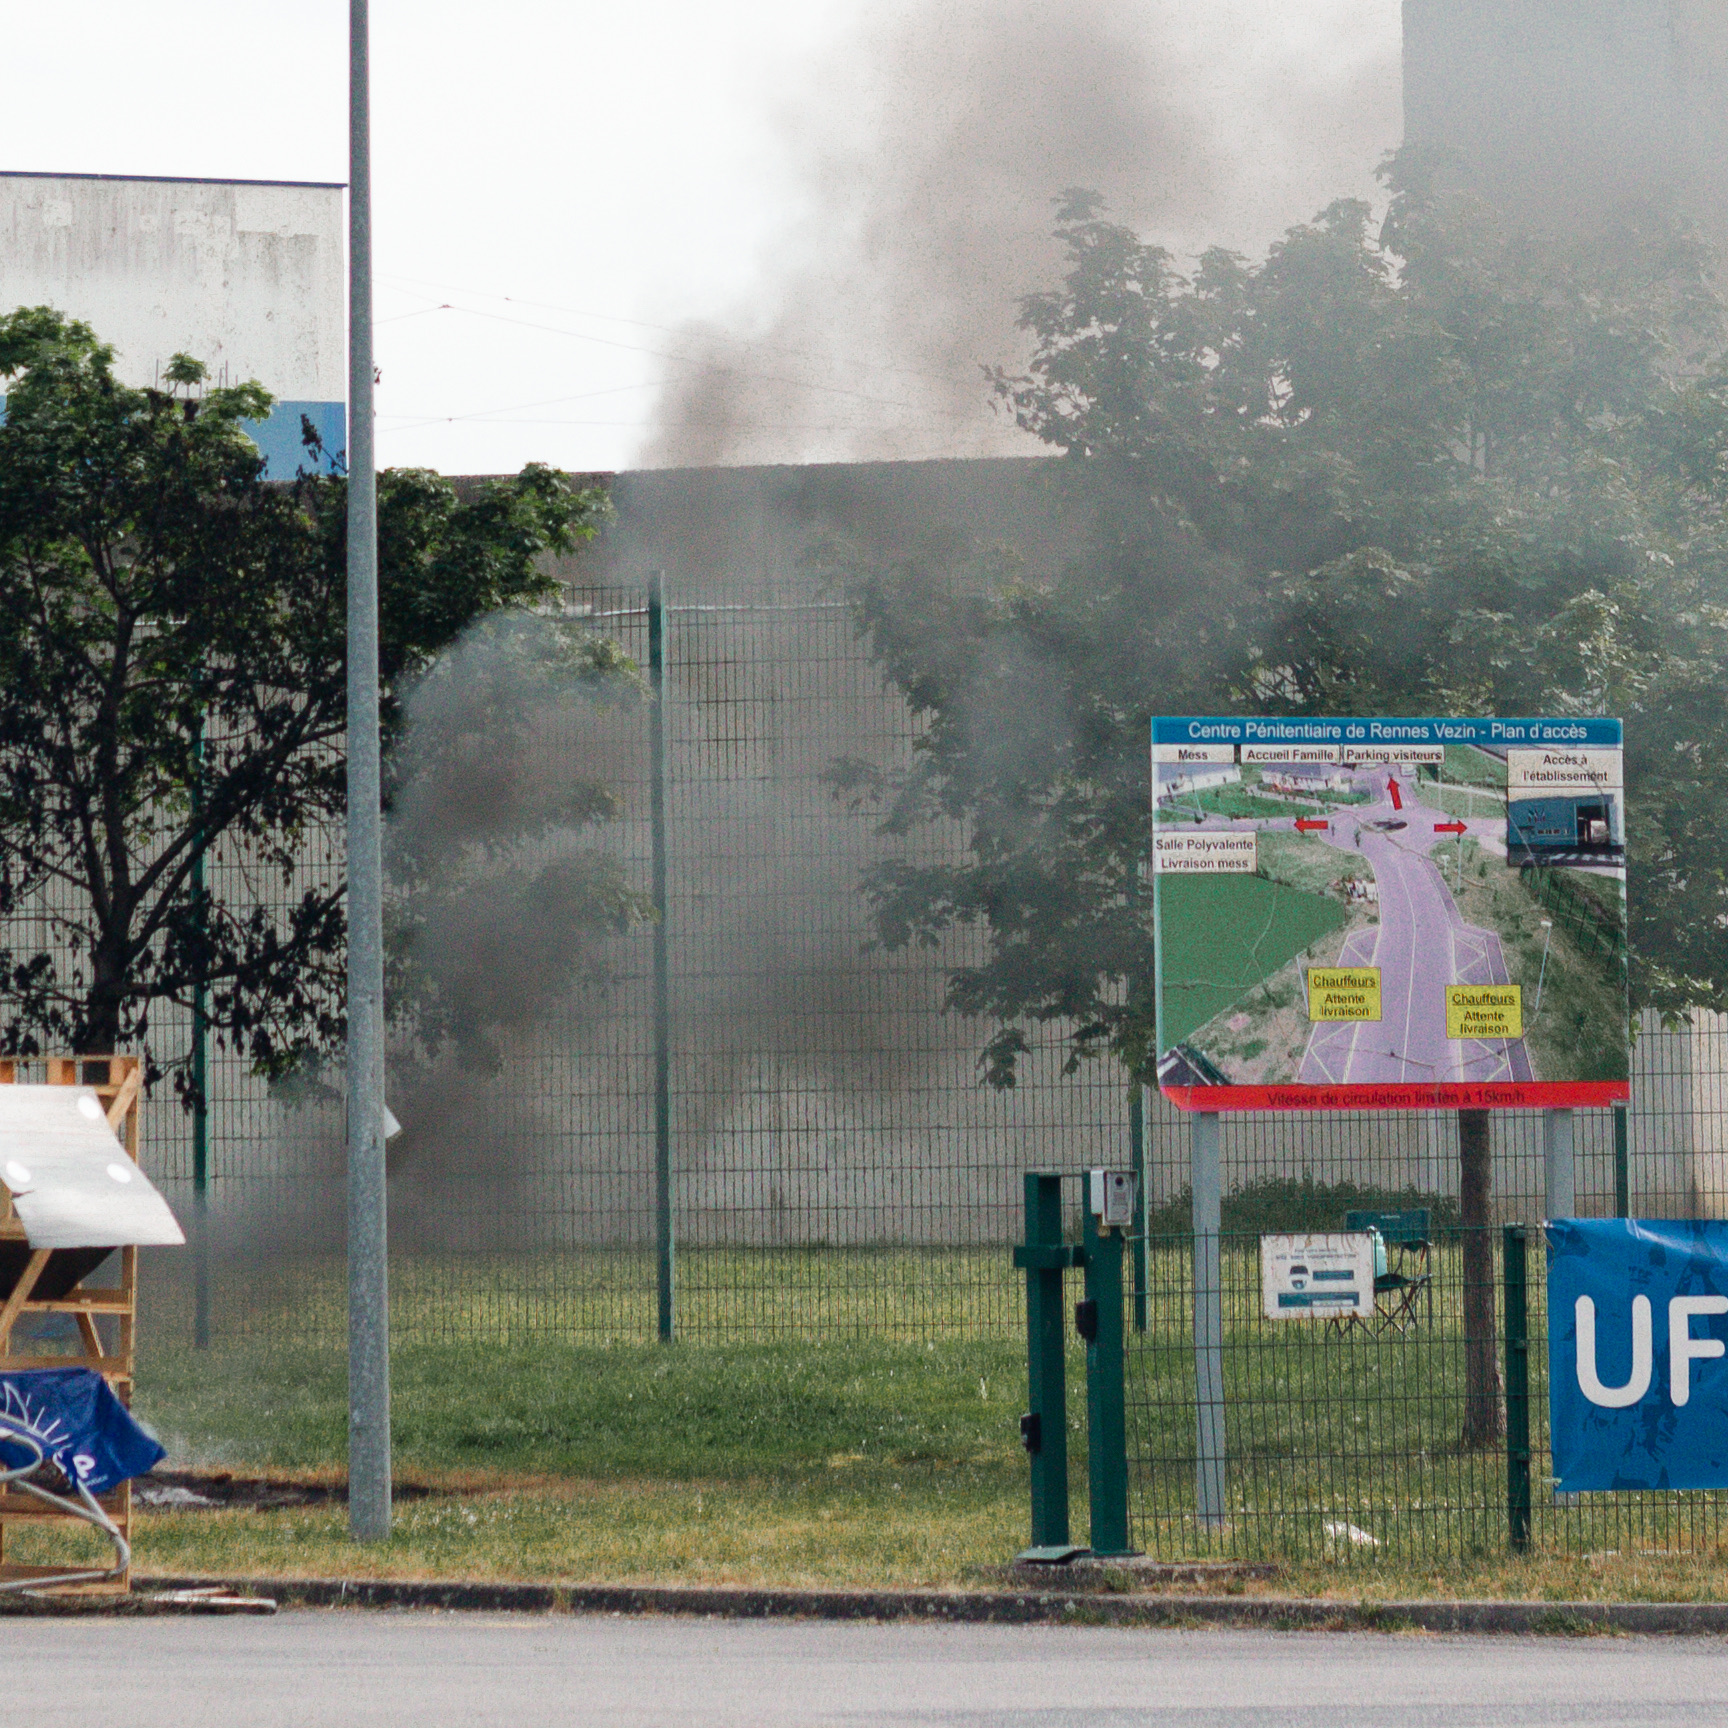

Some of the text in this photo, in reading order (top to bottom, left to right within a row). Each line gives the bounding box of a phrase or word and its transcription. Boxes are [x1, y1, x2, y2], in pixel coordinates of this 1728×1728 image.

[1188, 722, 1241, 739] Centre
[1245, 722, 1342, 739] Pénitentiaire
[1345, 722, 1366, 739] de
[1370, 723, 1430, 739] Rennes
[1433, 723, 1476, 738] Vezin
[1491, 723, 1526, 739] Plan
[1529, 722, 1588, 738] d'accès
[1177, 749, 1208, 760] Mess
[1246, 749, 1334, 760] Accueil Famille
[1346, 750, 1443, 763] Parking visiteurs
[1543, 753, 1588, 765] Accès à
[1523, 770, 1608, 782] l'établissement
[1156, 839, 1254, 852] Salle Polyvalente
[1161, 858, 1249, 869] Livraison mess
[1313, 975, 1376, 987] Chauffeurs
[1324, 993, 1365, 1004] Attente
[1452, 993, 1515, 1005] Chauffeurs
[1321, 1006, 1370, 1016] livraison
[1463, 1011, 1505, 1022] Attente
[1460, 1024, 1509, 1034] livraison
[1267, 1092, 1317, 1105] Vitesse
[1321, 1092, 1339, 1105] de
[1342, 1091, 1411, 1105] circulation
